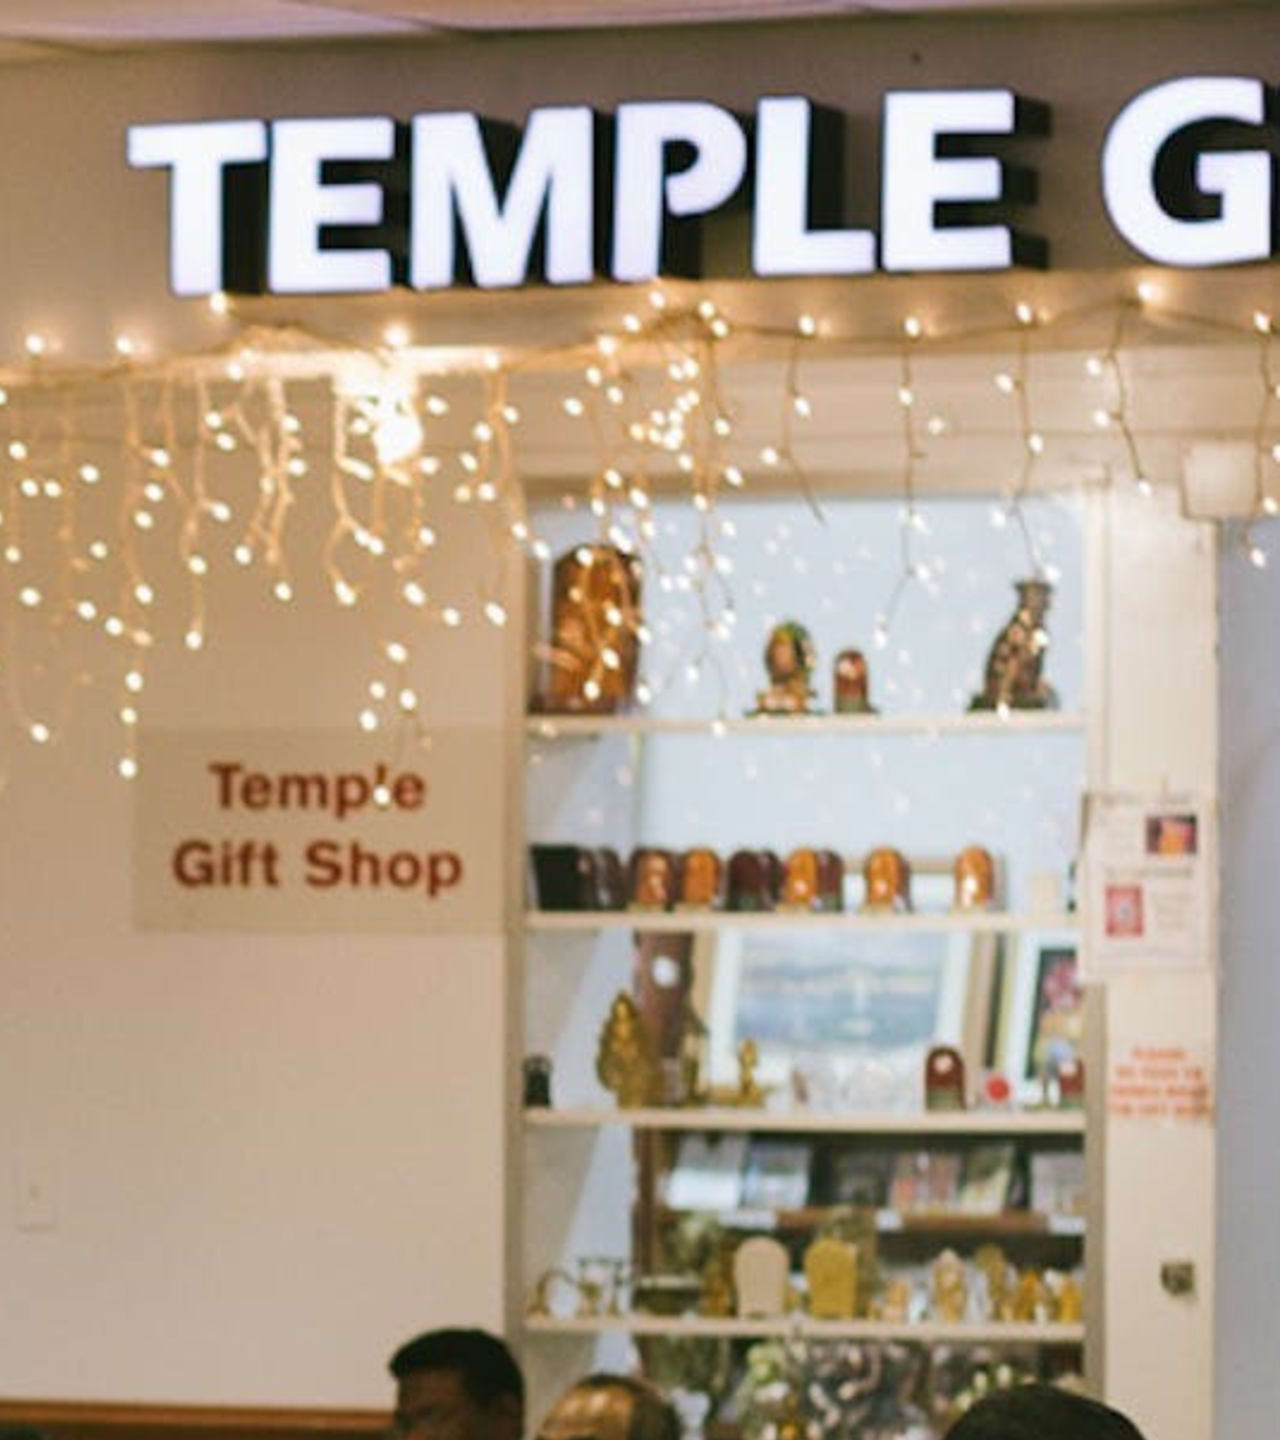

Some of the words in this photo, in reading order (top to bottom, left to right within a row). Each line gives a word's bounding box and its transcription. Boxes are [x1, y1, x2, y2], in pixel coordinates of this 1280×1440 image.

[127, 88, 1014, 296] TEMPLE
[172, 839, 281, 889] Gift
[304, 839, 464, 900] Shop
